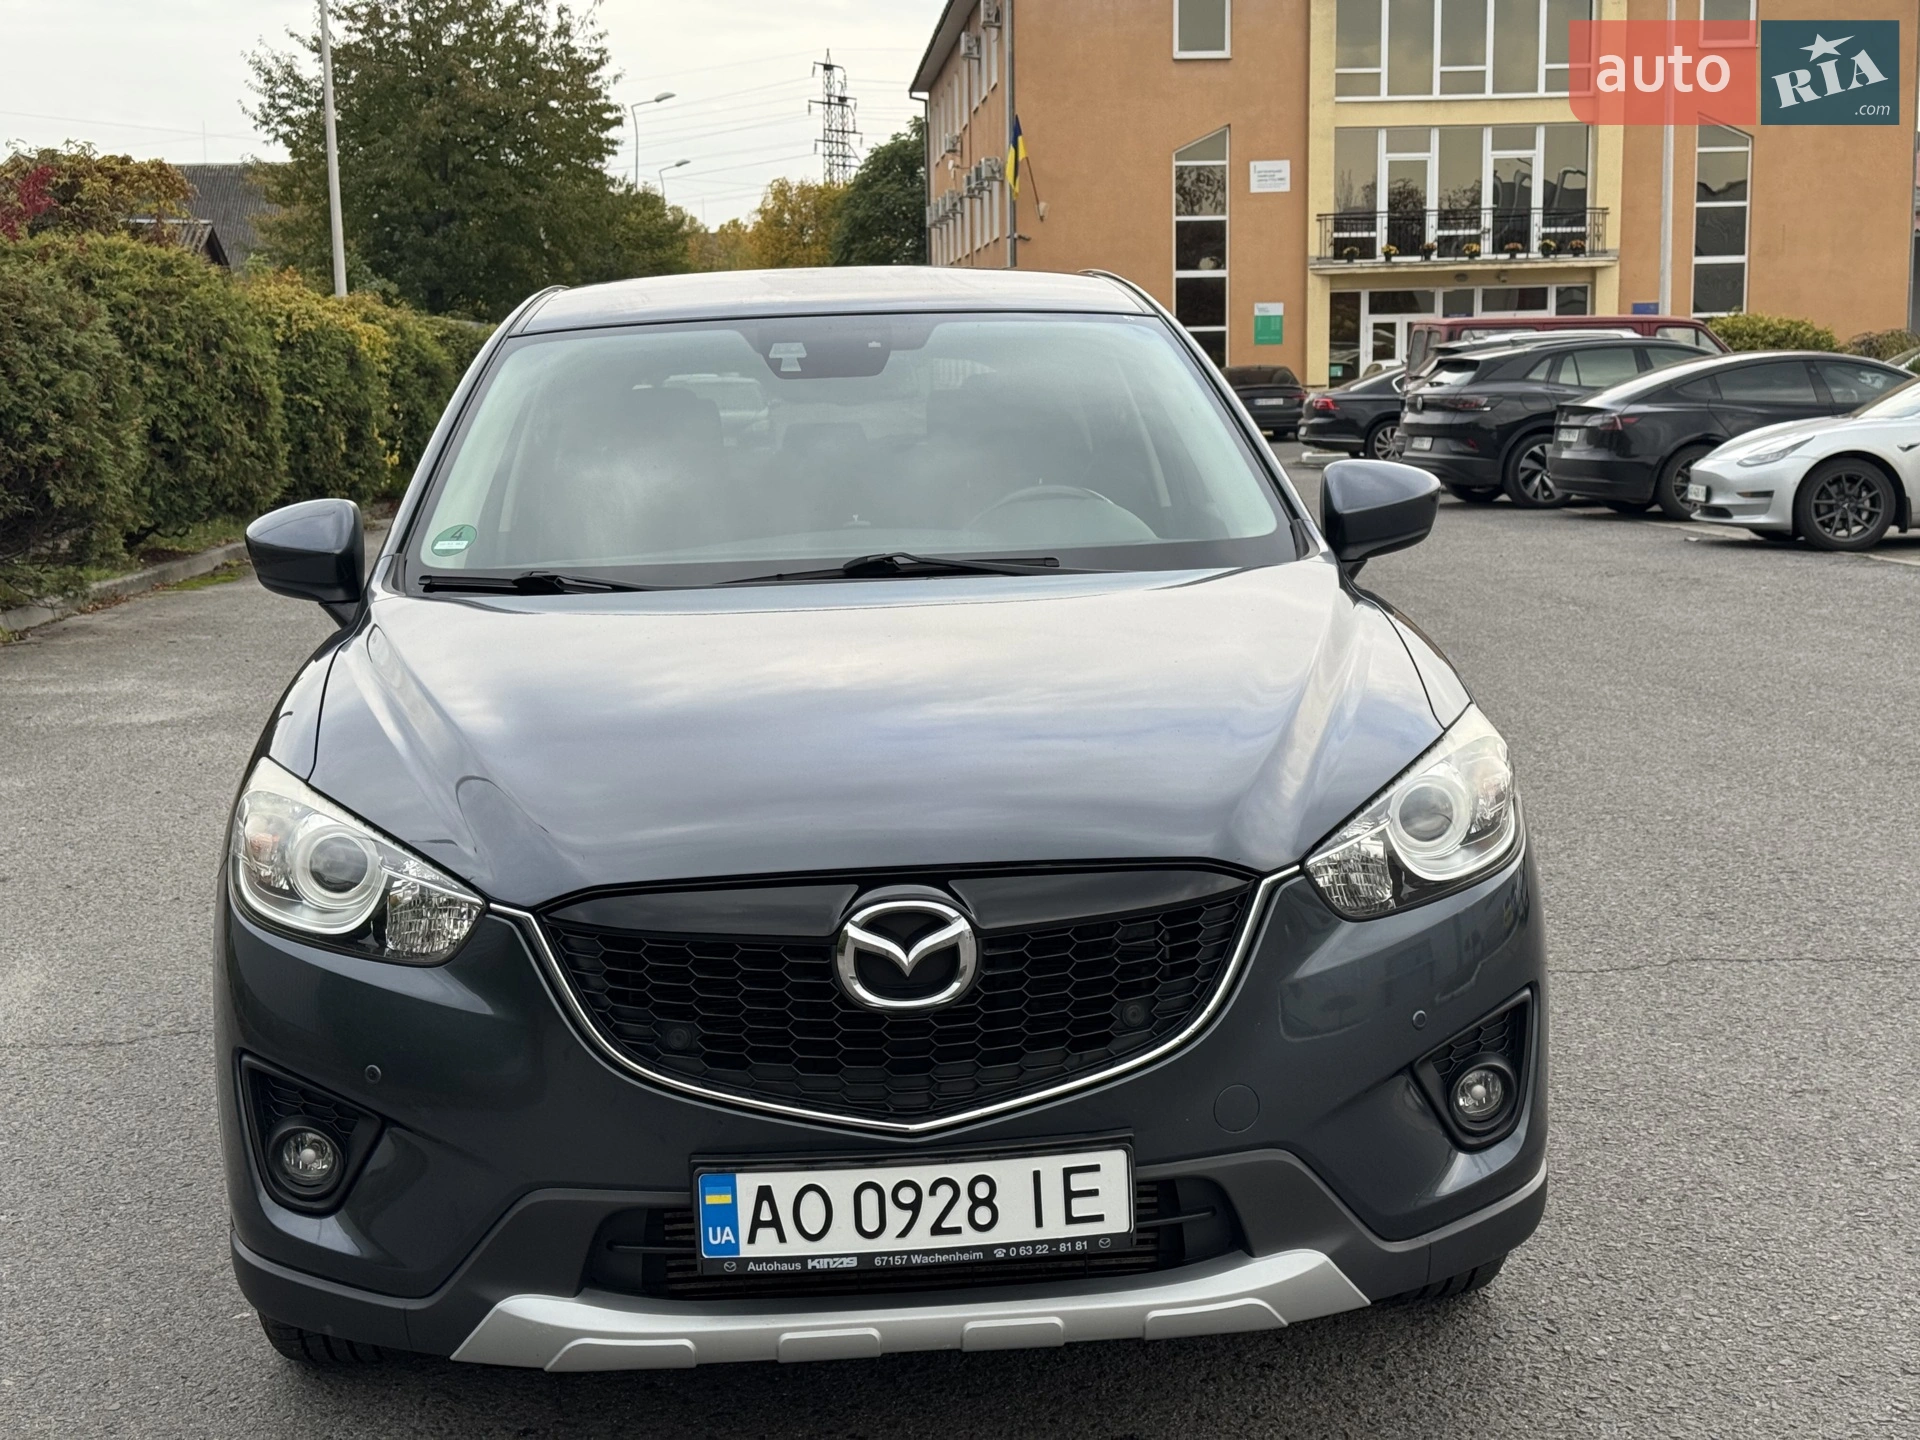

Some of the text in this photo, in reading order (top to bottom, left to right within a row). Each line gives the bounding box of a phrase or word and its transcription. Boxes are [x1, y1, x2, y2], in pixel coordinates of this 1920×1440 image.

[746, 1163, 1106, 1245] AO 0928 IE
[708, 1226, 736, 1246] UA
[747, 1260, 802, 1272] Autohaus
[874, 1255, 908, 1267] 67157
[910, 1250, 984, 1265] Wachenheim
[1009, 1246, 1017, 1257] 0
[1019, 1245, 1033, 1256] 63
[1035, 1244, 1049, 1255] 22
[1060, 1241, 1072, 1253] 81
[1075, 1240, 1088, 1251] 81
